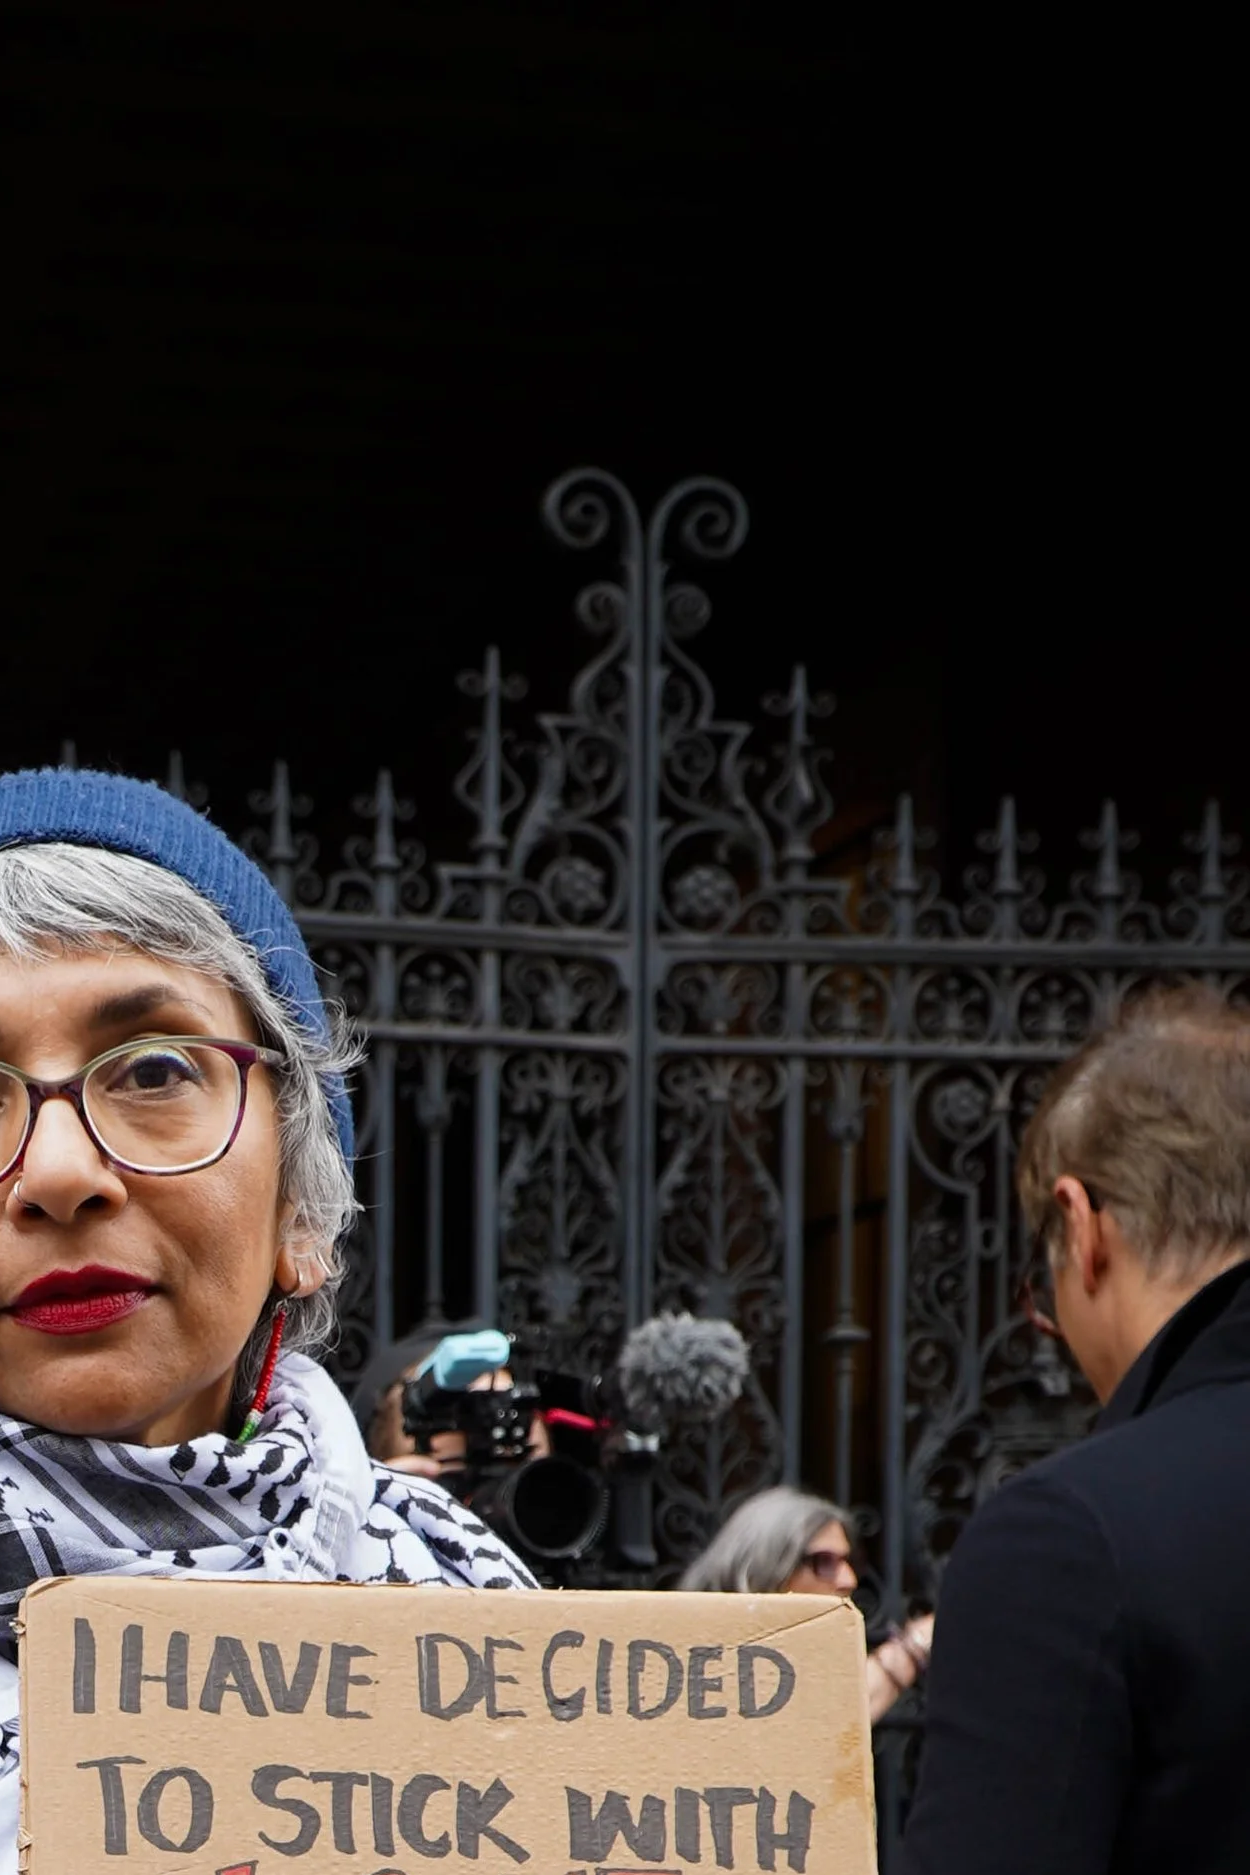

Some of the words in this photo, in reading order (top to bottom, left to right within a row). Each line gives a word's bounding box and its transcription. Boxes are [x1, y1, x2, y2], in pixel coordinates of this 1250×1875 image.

[73, 1618, 96, 1714] I
[118, 1622, 379, 1718] HAVE
[416, 1630, 797, 1721] DECIDED
[76, 1755, 214, 1857] TO
[251, 1764, 531, 1864] STICK
[564, 1785, 814, 1874] WITH
